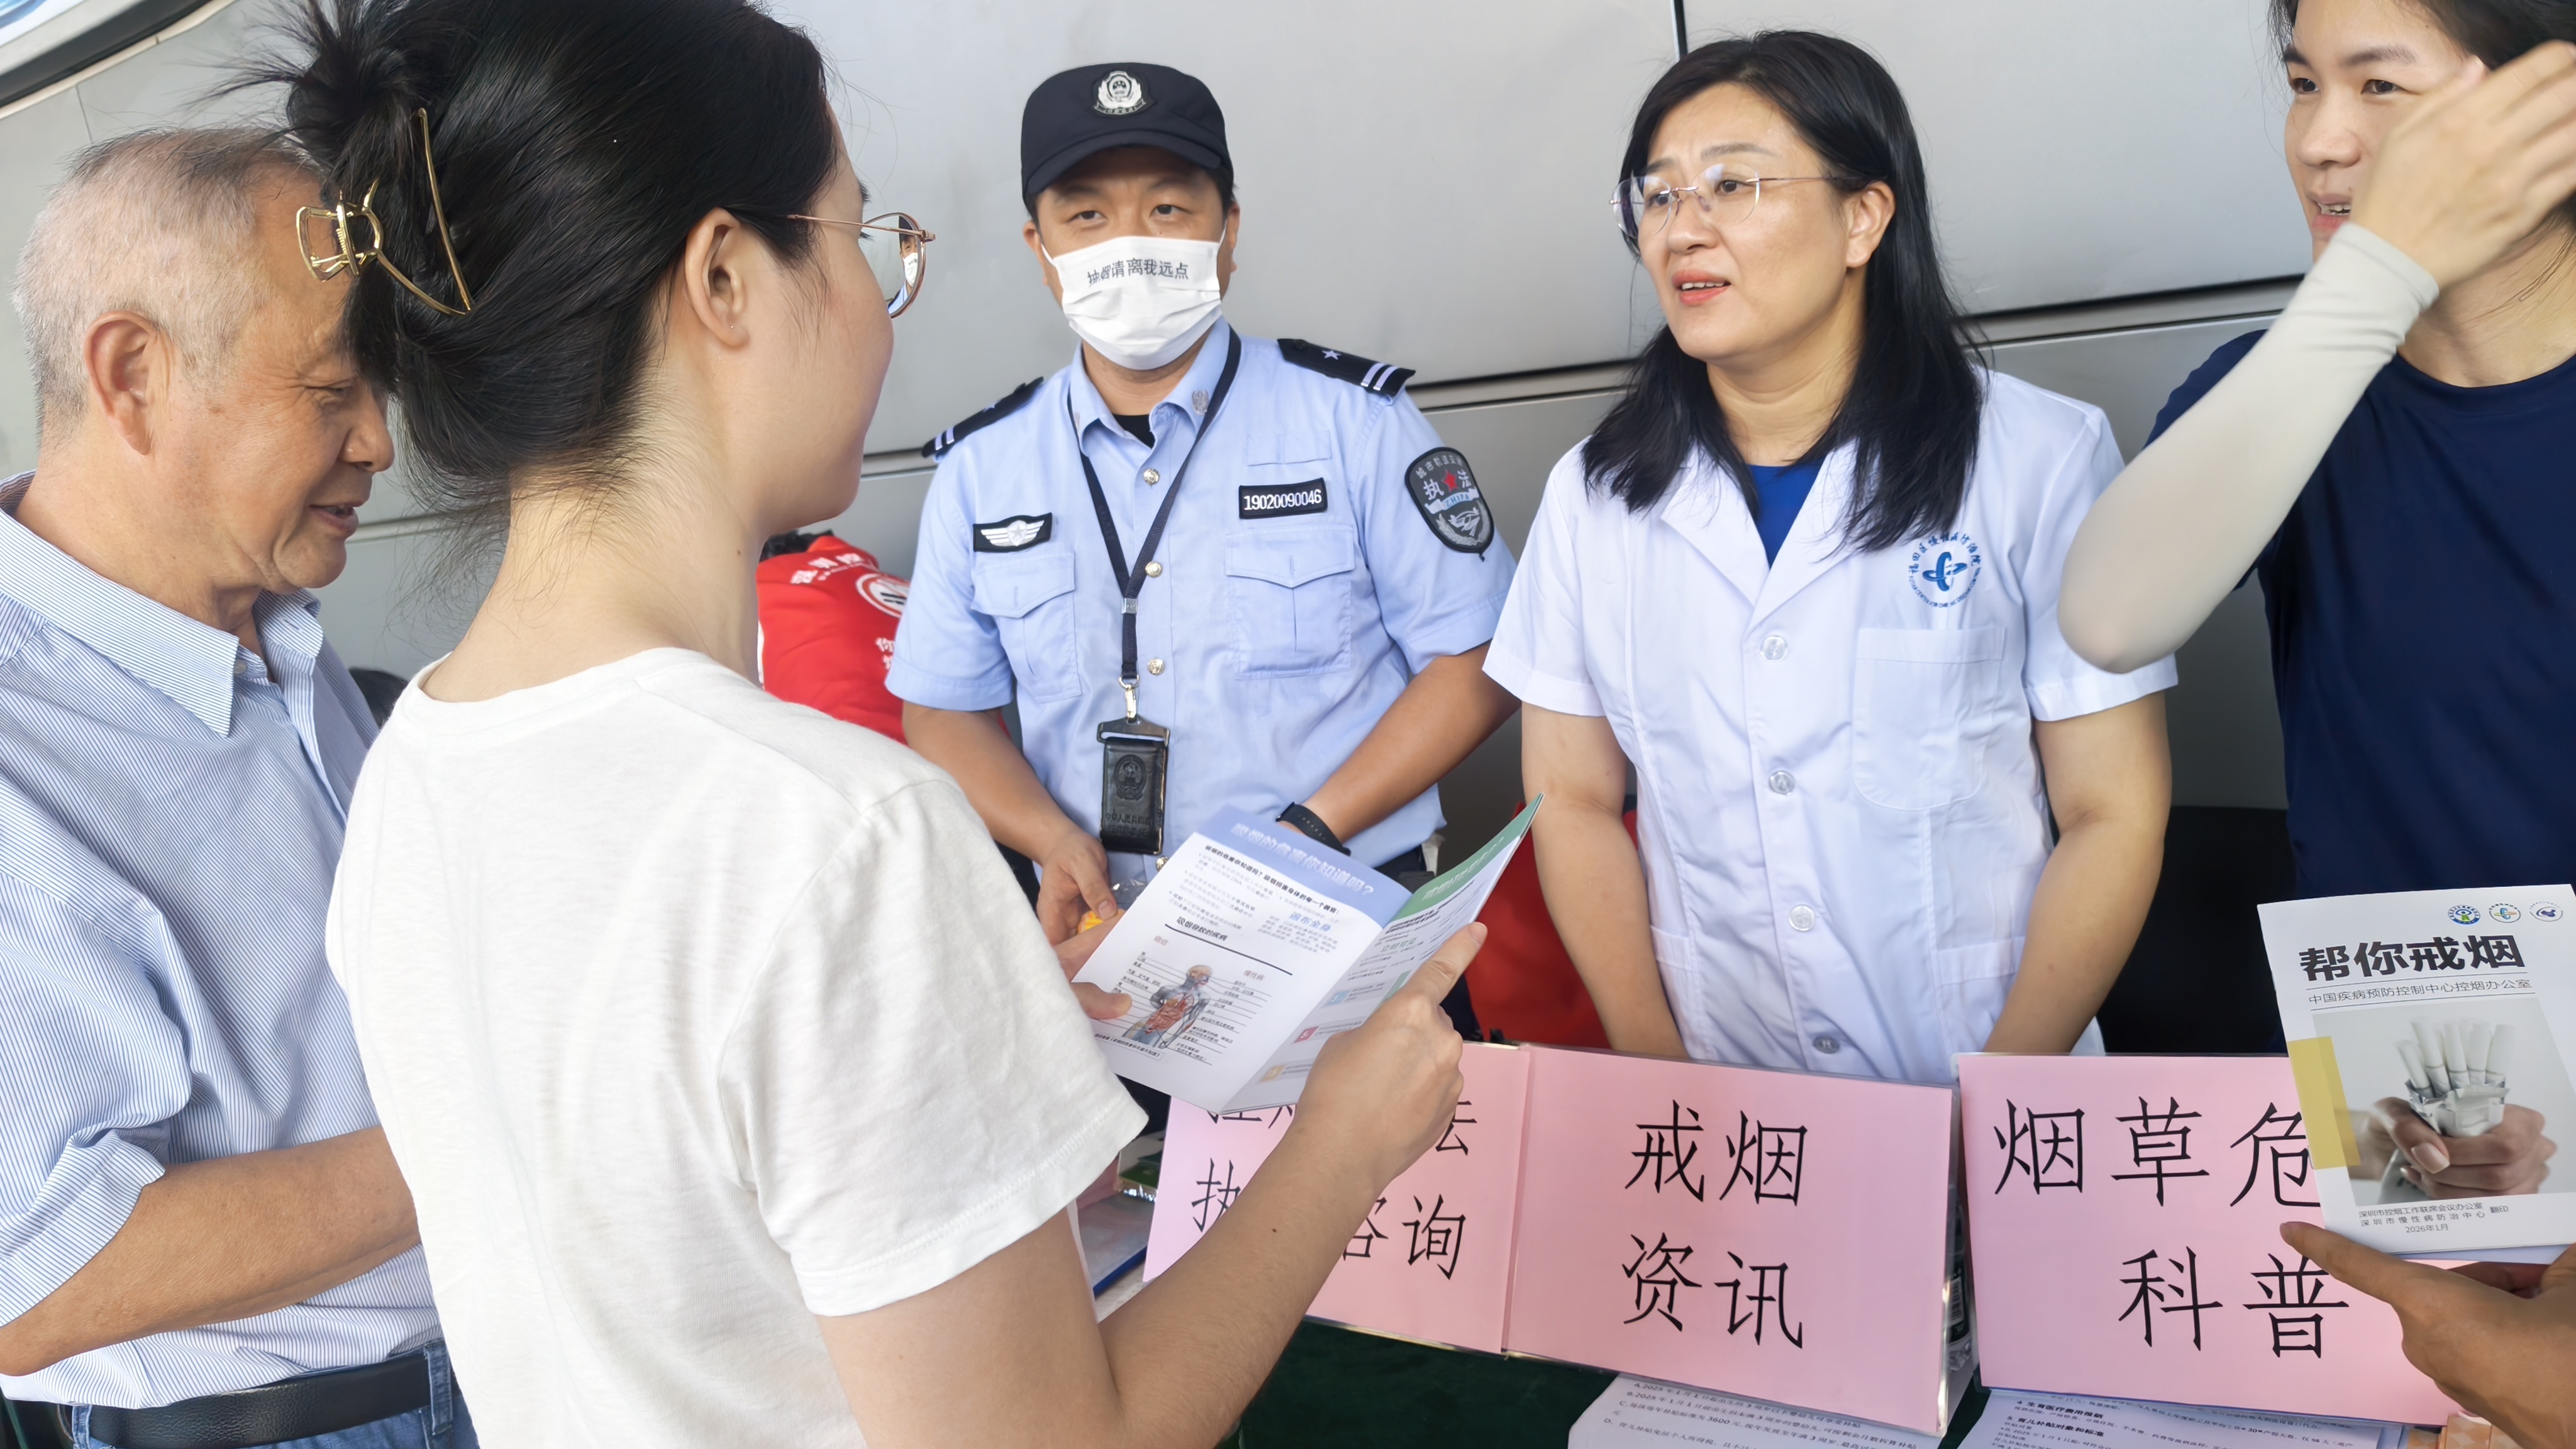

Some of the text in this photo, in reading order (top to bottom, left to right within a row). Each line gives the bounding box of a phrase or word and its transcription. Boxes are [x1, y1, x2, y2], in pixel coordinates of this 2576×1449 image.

[1087, 257, 1189, 287] 抽烟请离我远点
[1243, 488, 1322, 511] 19020090046
[1446, 493, 1470, 508] ZHIFA
[2298, 934, 2526, 982] 帮你戒烟
[2308, 979, 2533, 1005] 中国疾病预防控制中心控烟办公室
[1624, 1097, 1810, 1209] 戒烟
[2358, 1202, 2509, 1219] 深圳市控烟工作联席会议办公室 翻印
[2360, 1211, 2486, 1227] 深圳市慢性病防治中心
[1620, 1231, 1806, 1350] 资讯
[2117, 1246, 2351, 1360] 科普
